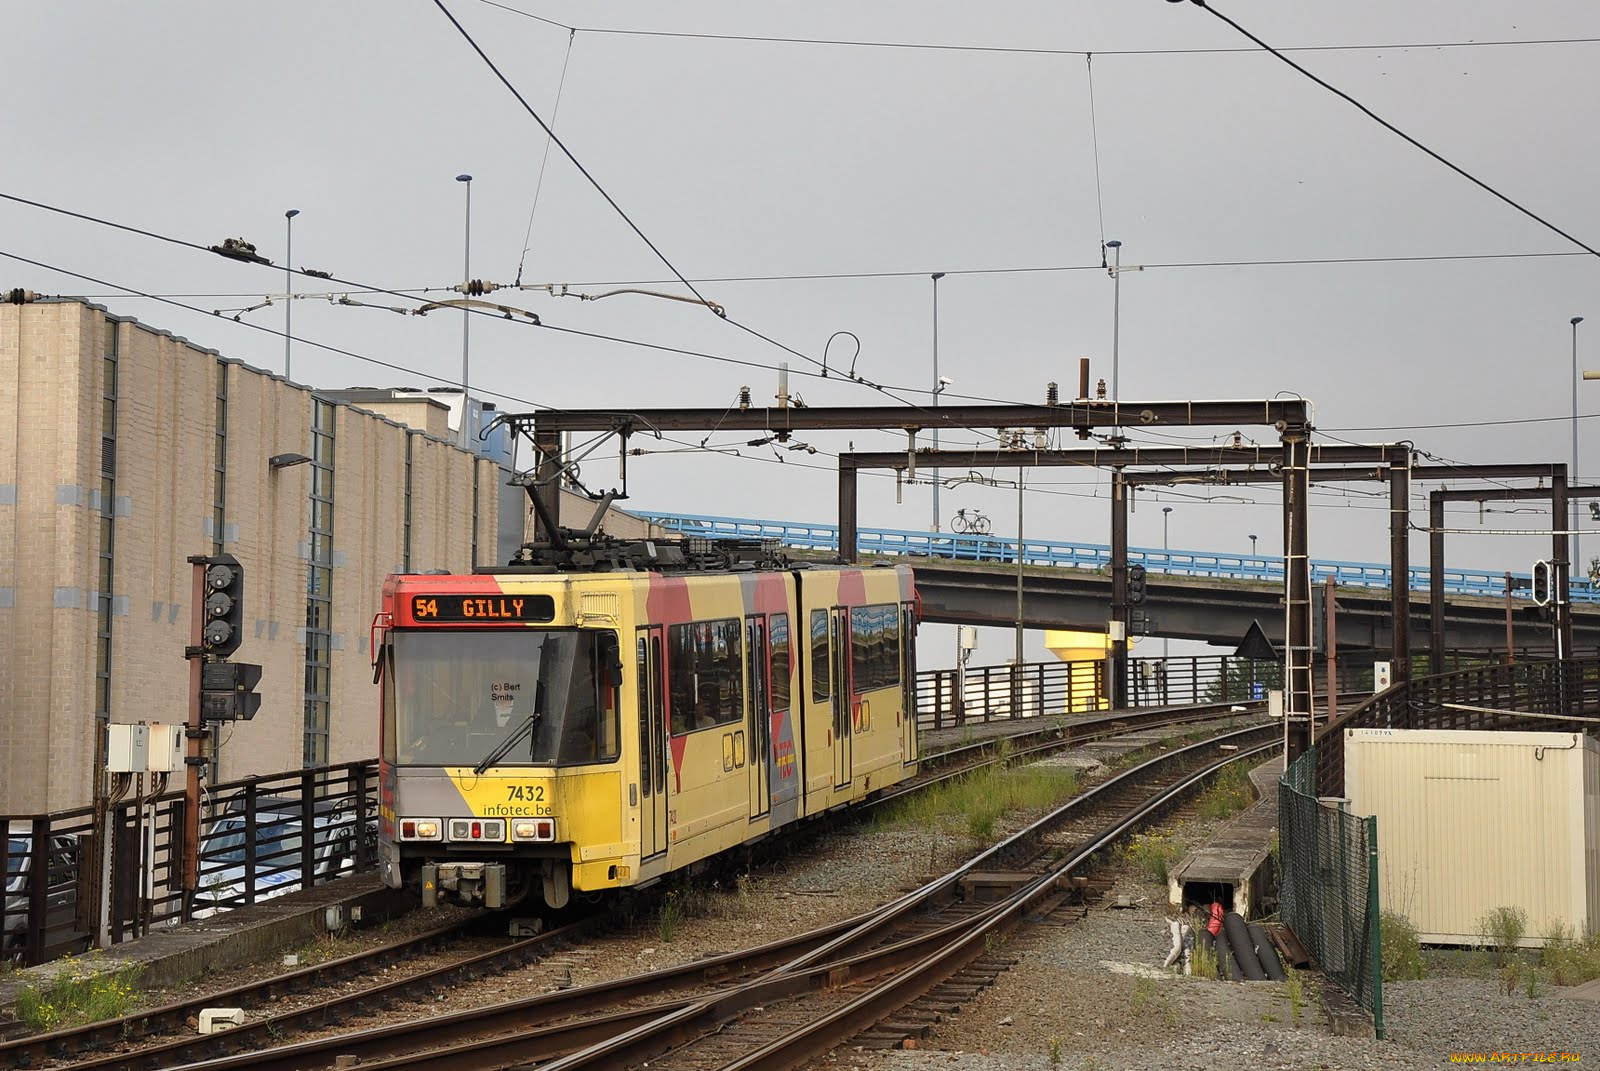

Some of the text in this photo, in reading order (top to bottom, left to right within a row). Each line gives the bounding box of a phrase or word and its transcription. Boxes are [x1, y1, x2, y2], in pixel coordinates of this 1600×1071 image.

[415, 599, 524, 617] 54 GILLY
[507, 785, 544, 801] 7432
[483, 803, 552, 816] infotec.be
